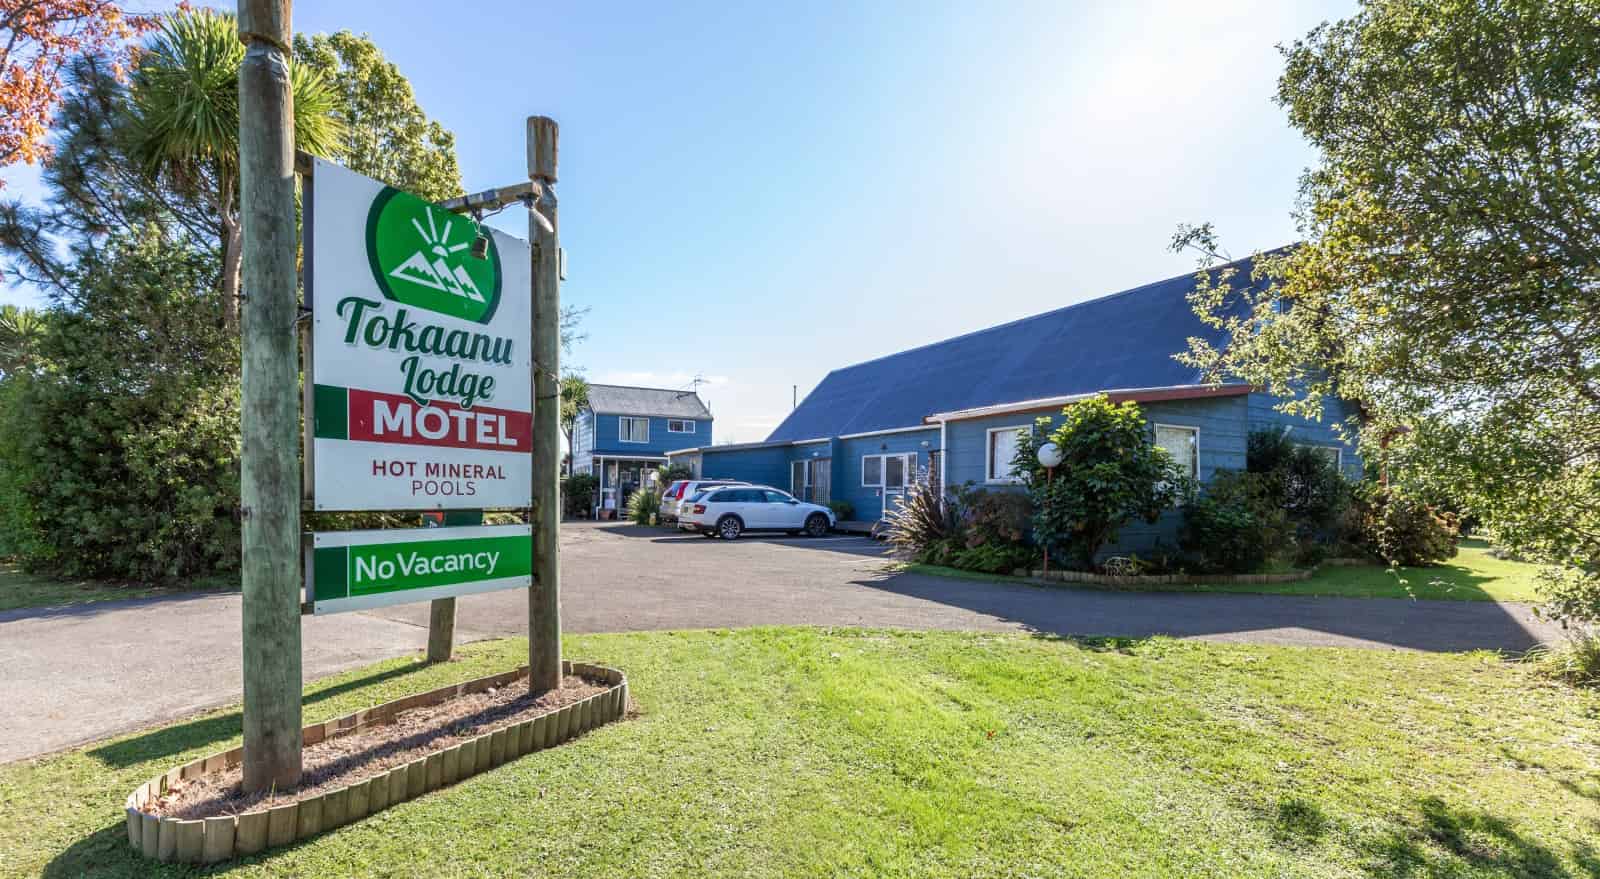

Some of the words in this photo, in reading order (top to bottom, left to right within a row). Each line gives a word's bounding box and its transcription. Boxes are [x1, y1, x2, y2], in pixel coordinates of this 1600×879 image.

[336, 296, 513, 364] Tokaanu
[401, 356, 494, 409] Lodge
[373, 400, 518, 446] MOTEL
[372, 460, 417, 477] HOT
[425, 463, 506, 480] MINERAL
[412, 480, 476, 496] POOLS
[355, 556, 395, 582] No
[397, 551, 500, 576] Vacancy
